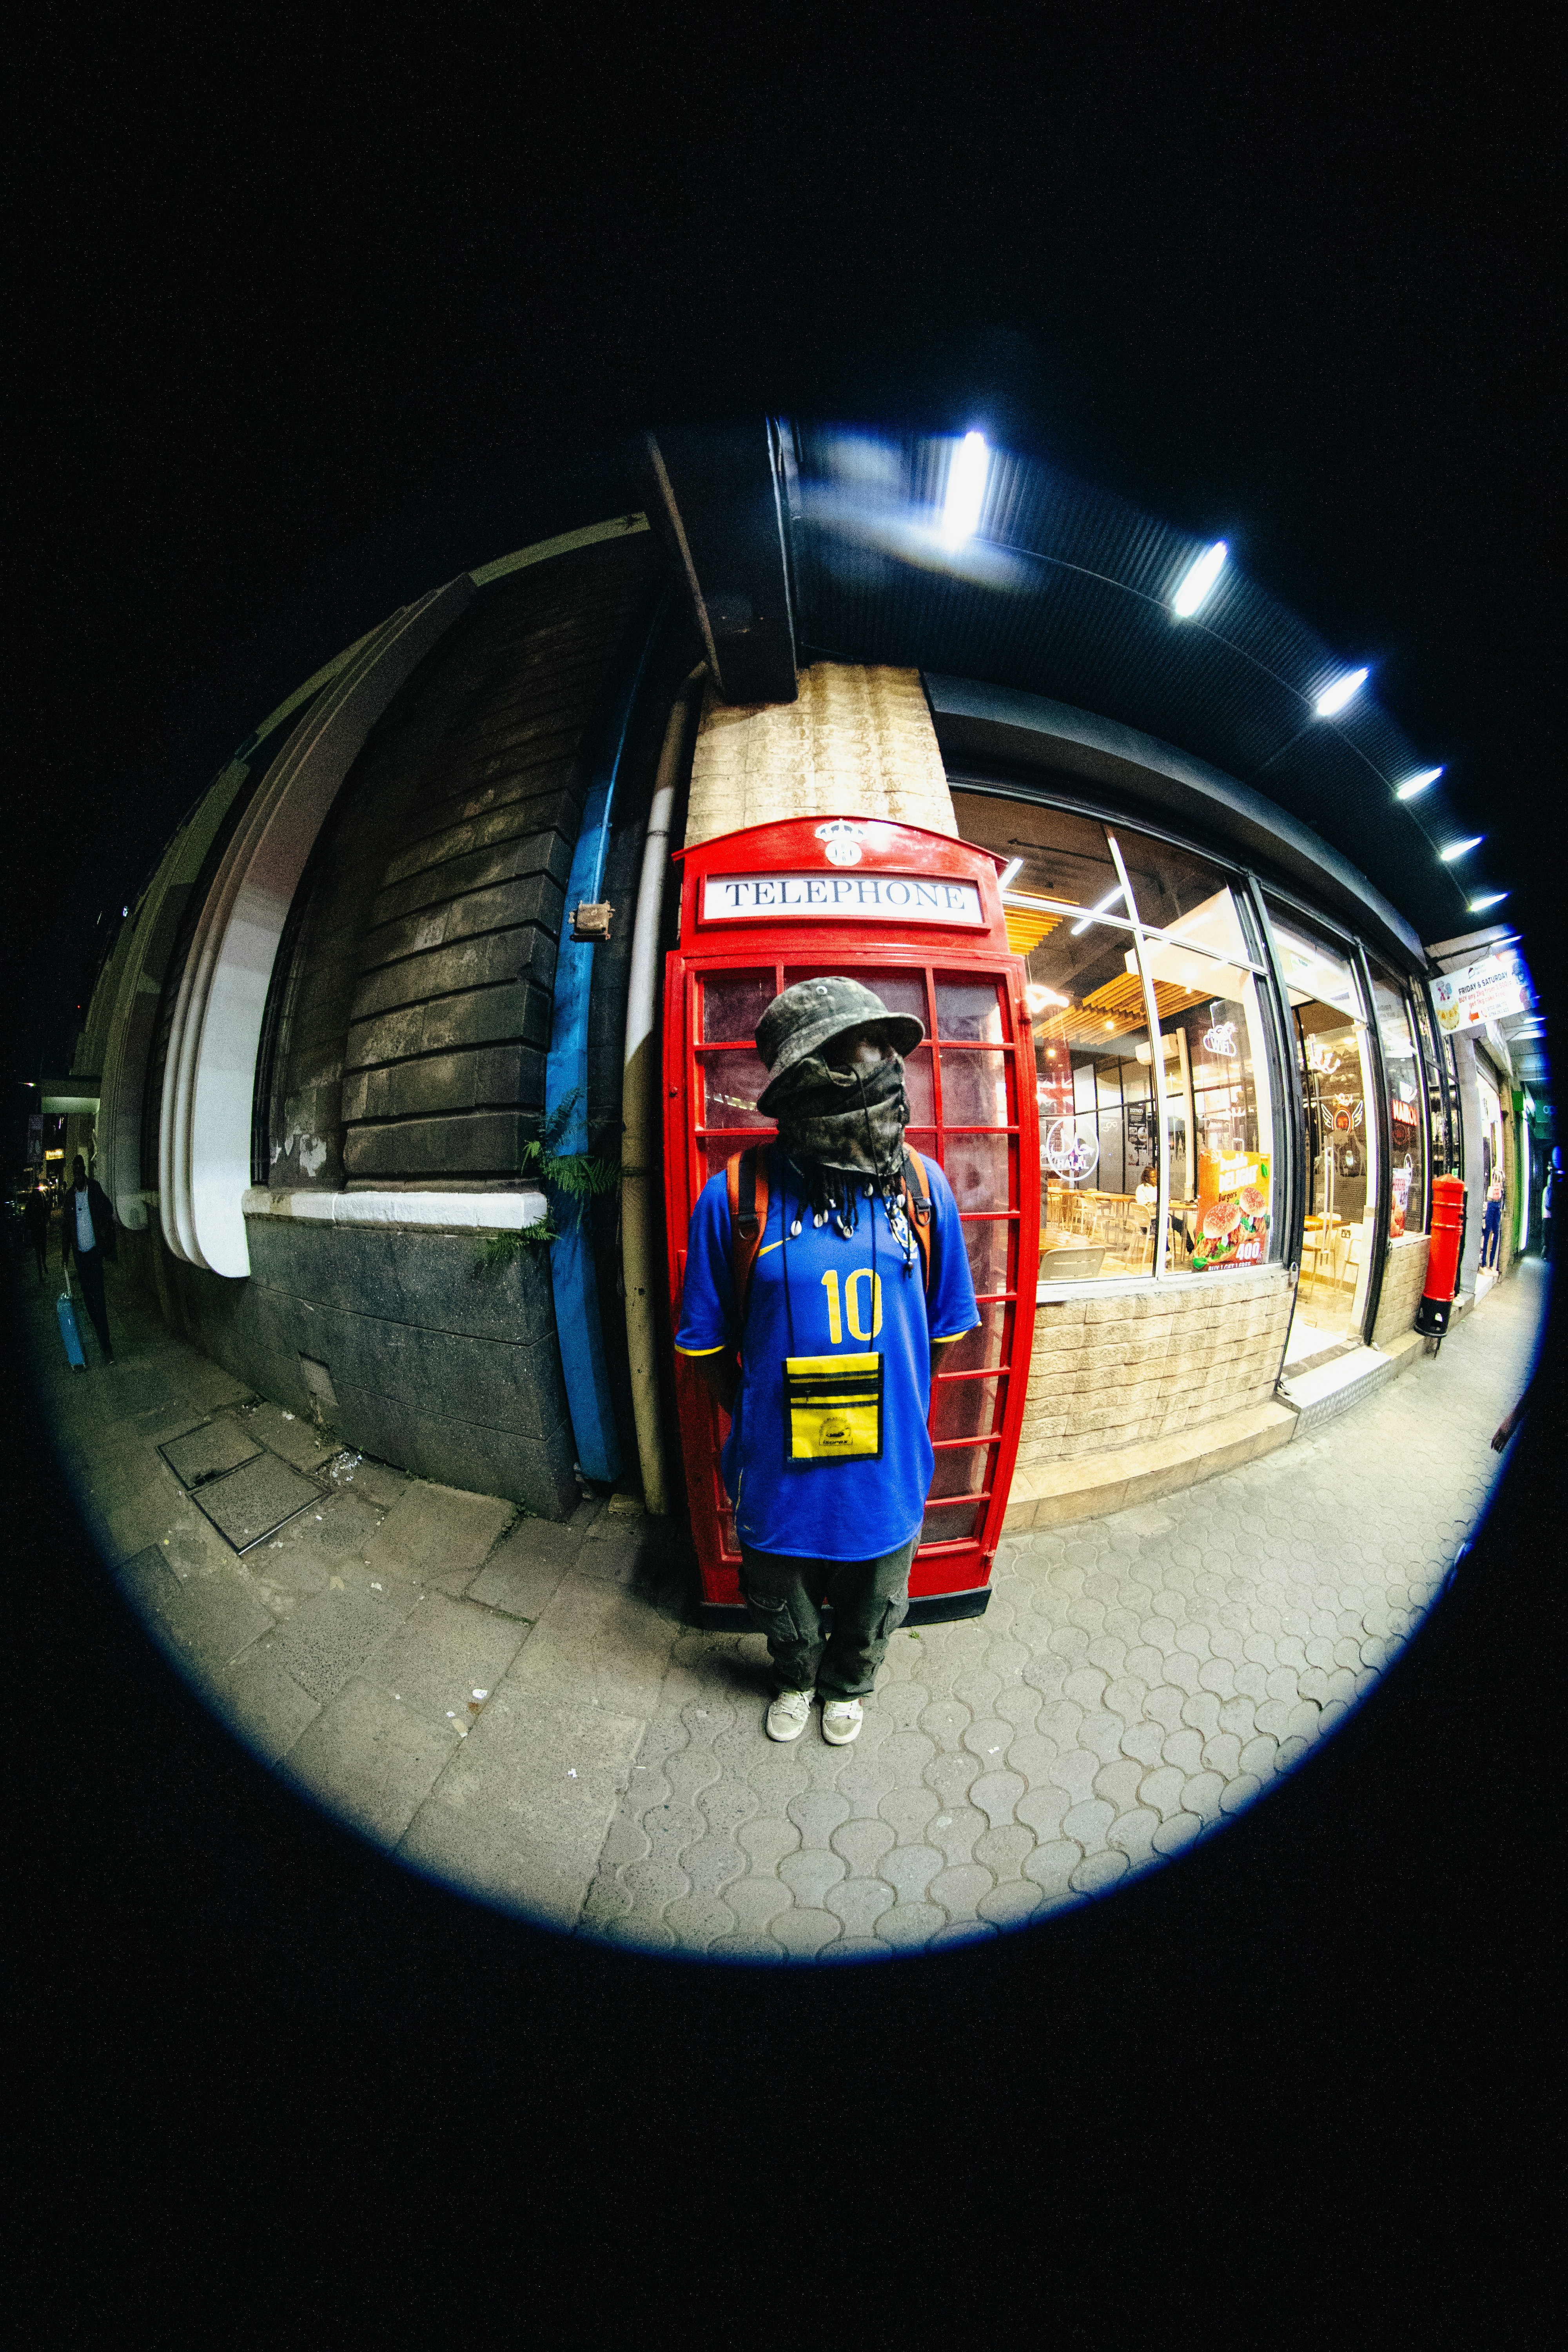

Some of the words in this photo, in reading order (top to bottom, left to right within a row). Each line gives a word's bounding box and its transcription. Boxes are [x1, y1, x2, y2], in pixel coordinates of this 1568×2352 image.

[726, 880, 965, 910] TELEPHONE
[1458, 982, 1476, 995] FRIDAY
[1481, 971, 1508, 987] SATURDAY
[1057, 1158, 1089, 1170] HALAL
[1219, 1164, 1259, 1193] DELIGHT
[1219, 1191, 1237, 1202] Burgers
[1236, 1241, 1260, 1261] 400
[821, 1268, 883, 1344] 10
